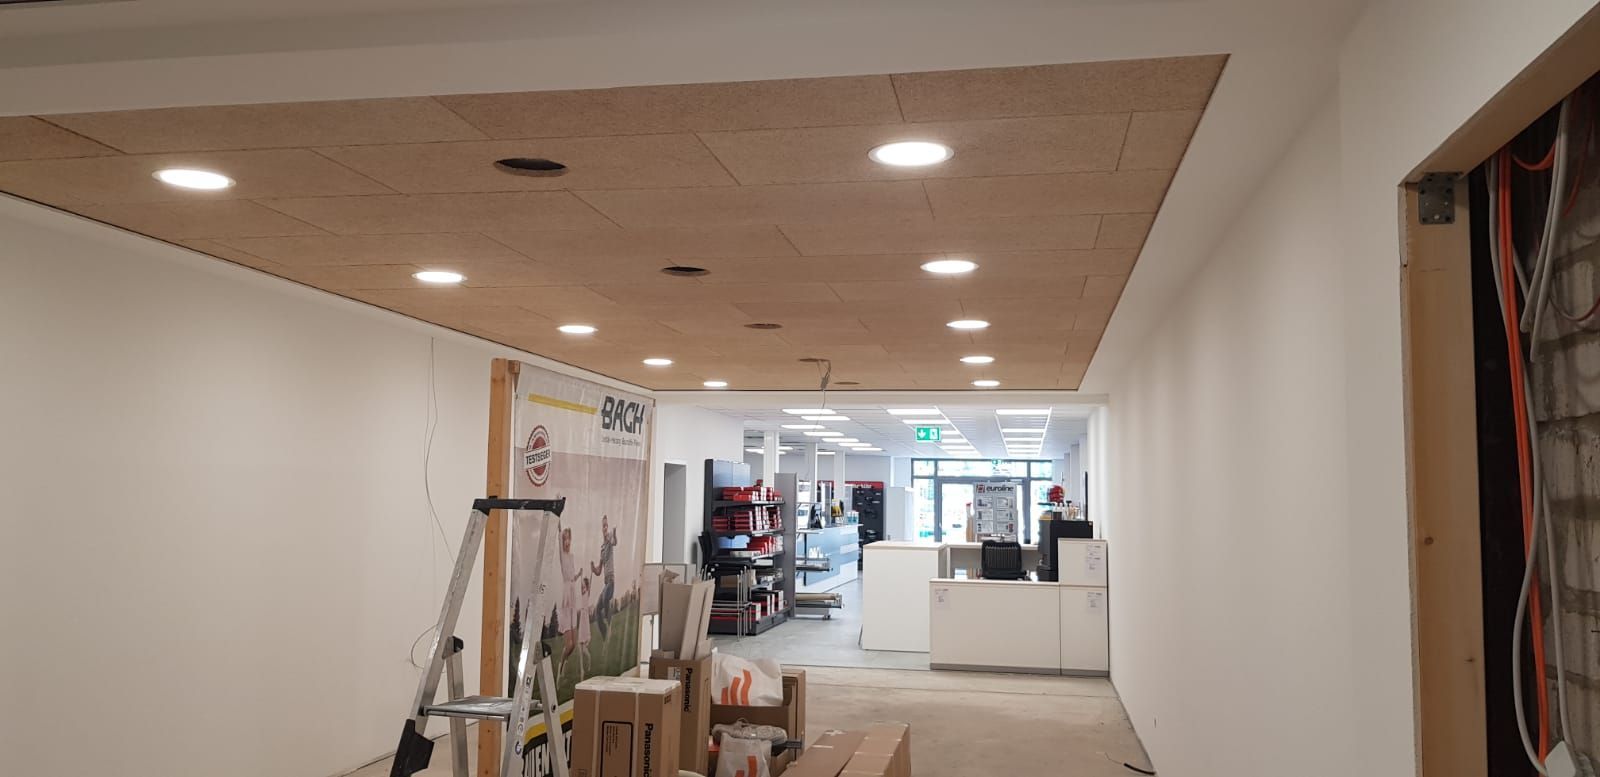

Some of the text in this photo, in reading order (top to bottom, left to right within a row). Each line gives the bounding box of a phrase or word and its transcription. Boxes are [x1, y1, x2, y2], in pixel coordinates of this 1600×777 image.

[601, 395, 645, 435] BACH
[986, 484, 1014, 493] euroline
[684, 667, 693, 712] Panasonic
[643, 723, 654, 777] Panasonic
